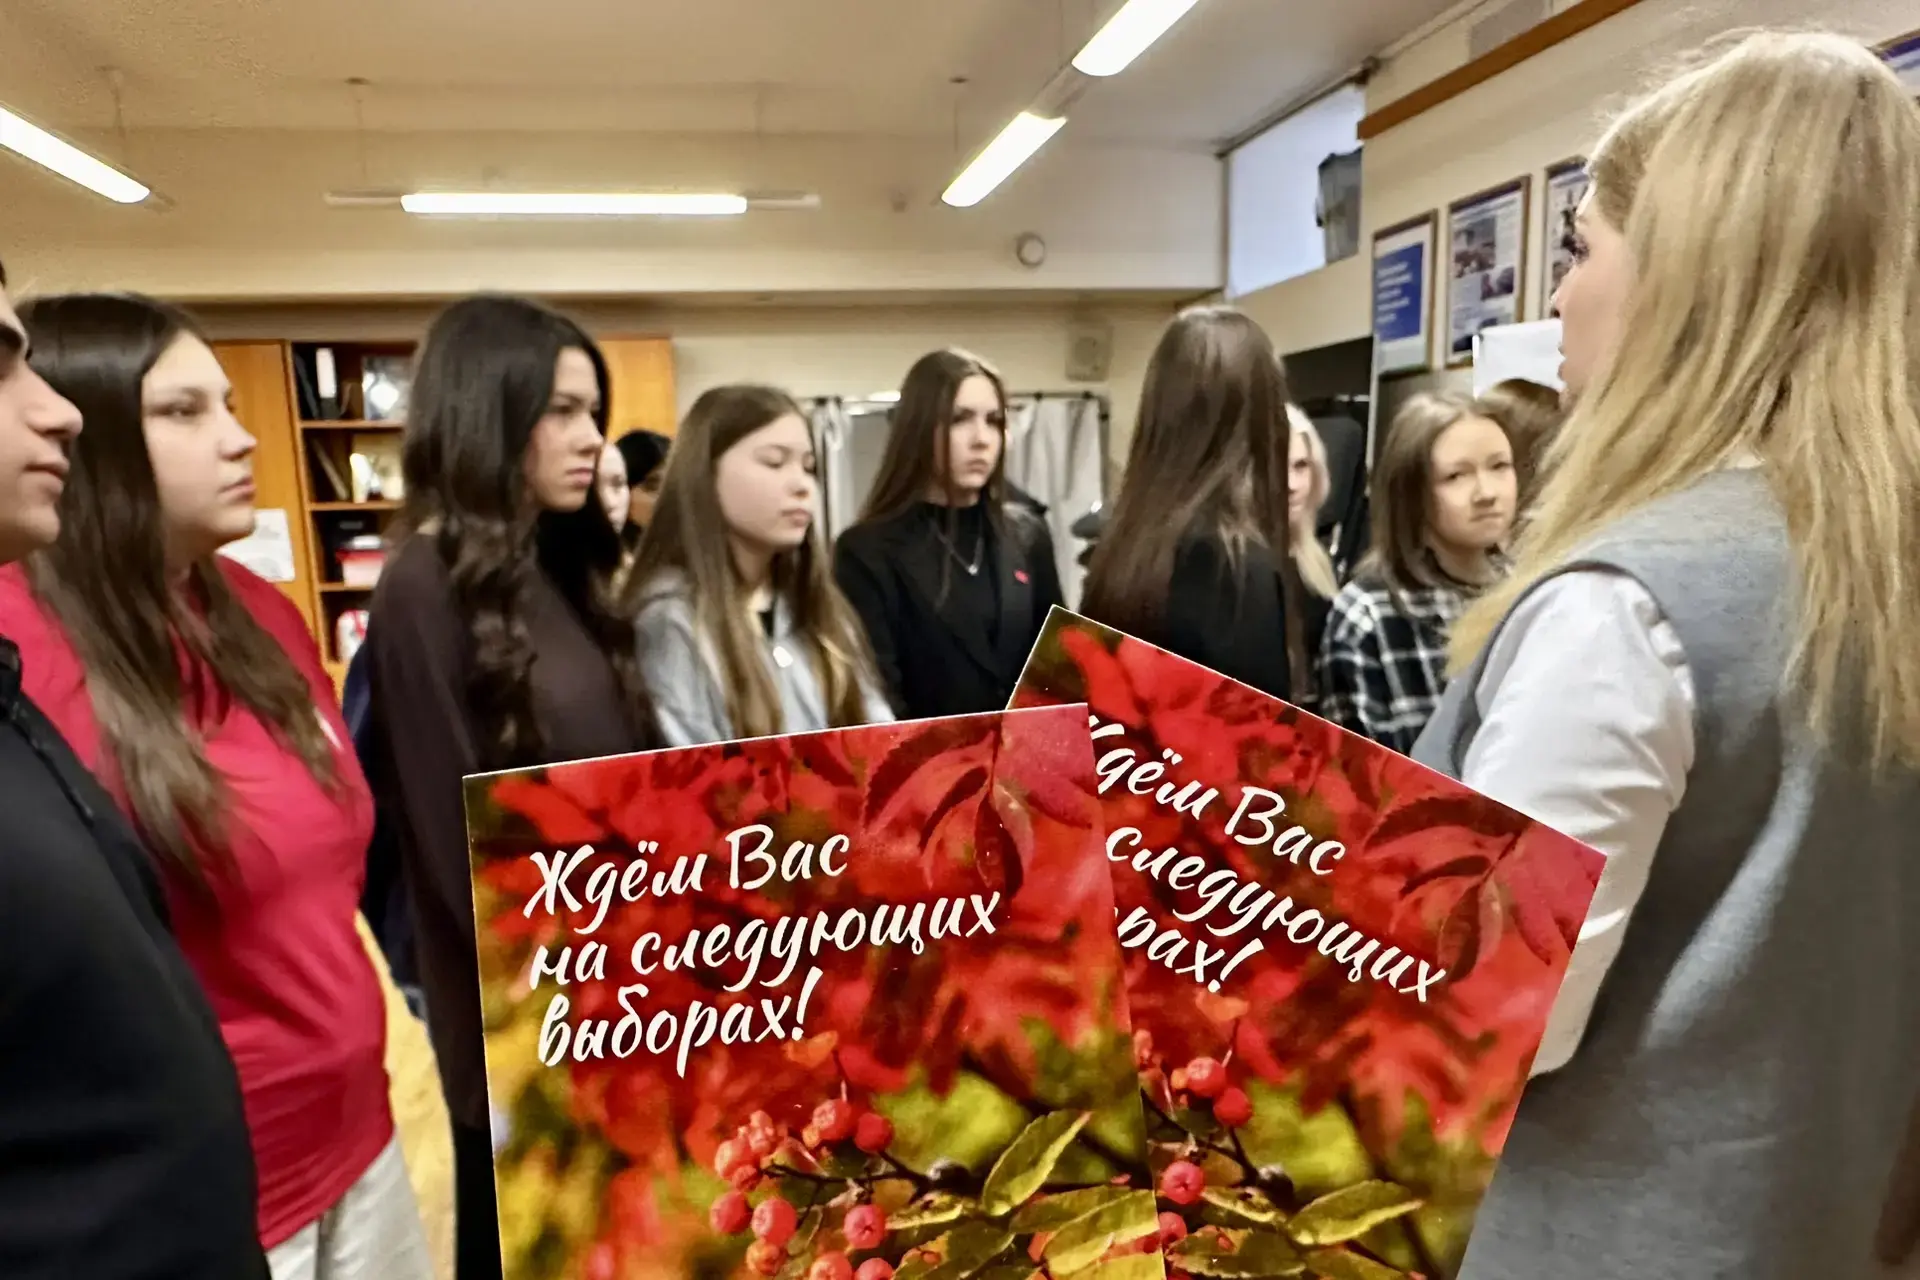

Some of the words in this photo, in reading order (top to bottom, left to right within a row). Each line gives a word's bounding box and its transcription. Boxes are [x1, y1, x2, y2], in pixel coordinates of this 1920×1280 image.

[1088, 714, 1219, 820] дём
[1223, 786, 1346, 875] Вас
[523, 839, 708, 934] Ждём
[725, 824, 851, 890] Вас
[1105, 826, 1447, 1003] следующих
[528, 940, 608, 990] на
[631, 891, 1001, 992] следующих
[1114, 905, 1265, 993] рах!
[537, 966, 824, 1078] выборах!
